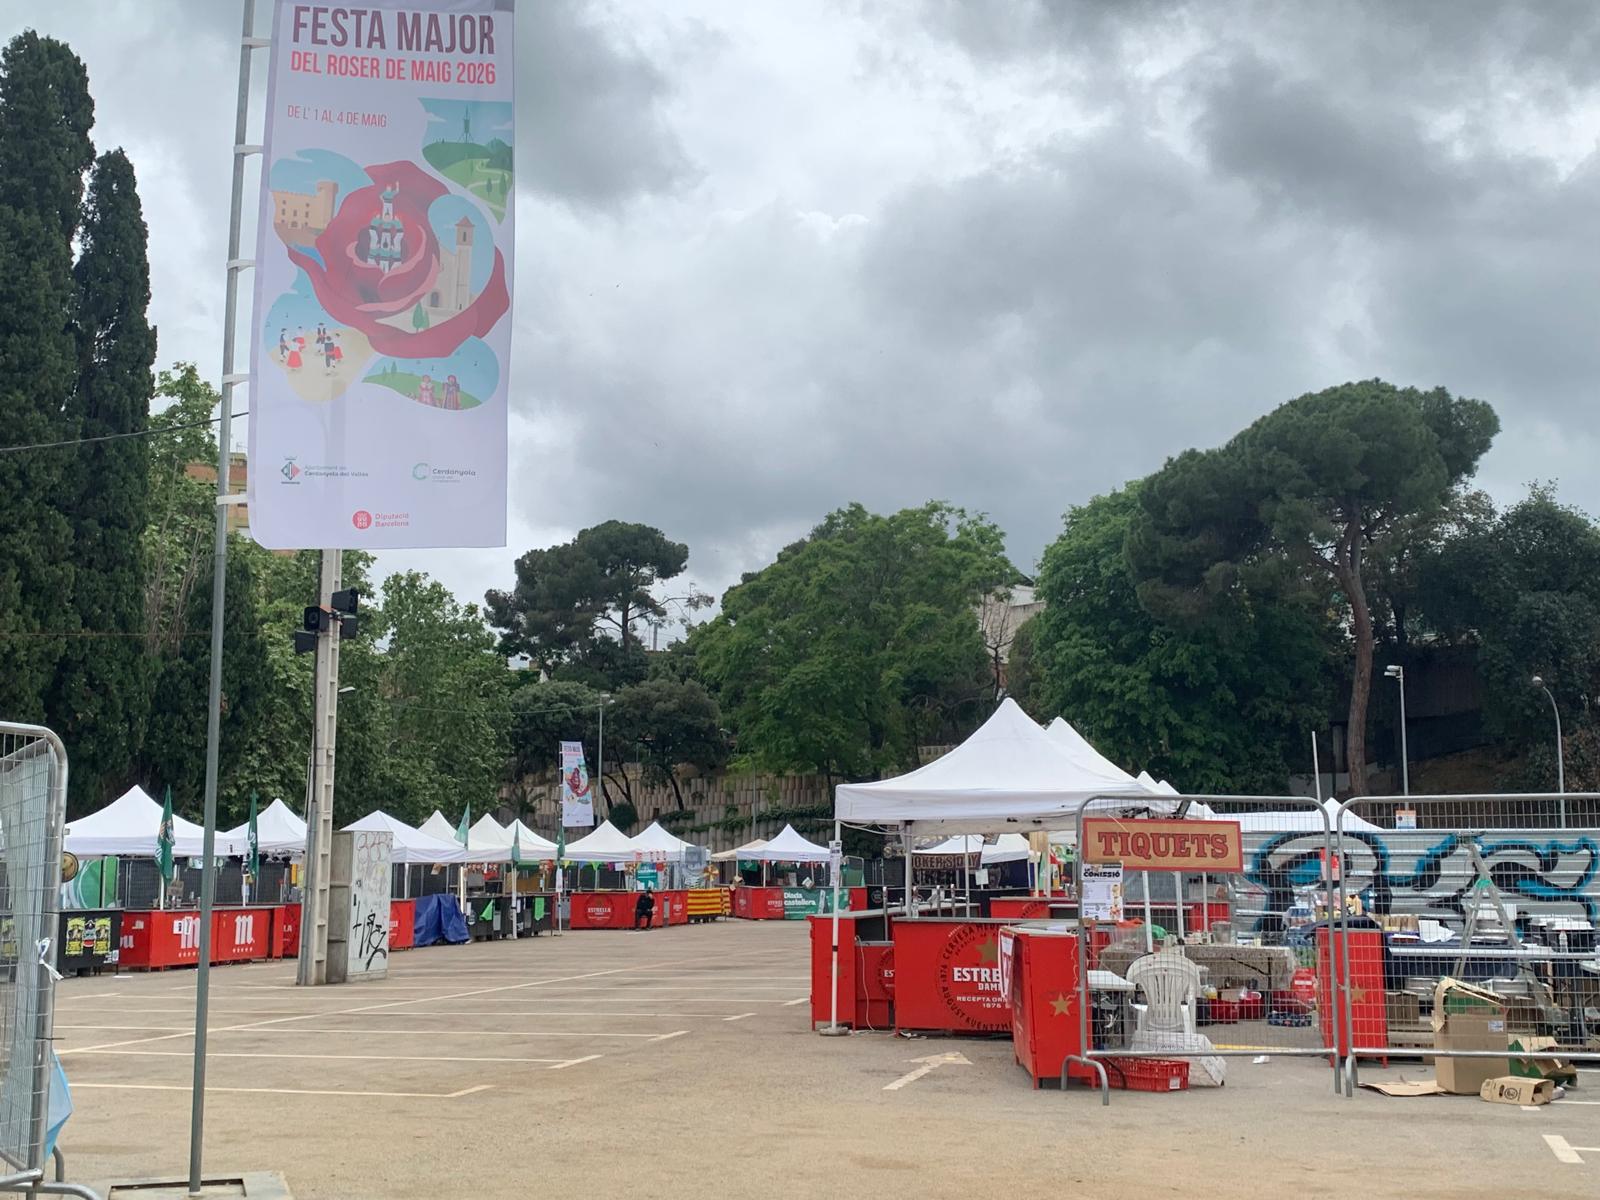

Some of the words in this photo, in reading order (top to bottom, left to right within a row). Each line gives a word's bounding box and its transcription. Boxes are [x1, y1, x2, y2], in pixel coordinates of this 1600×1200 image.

[293, 6, 386, 50] FESTA
[397, 12, 495, 55] MAJOR
[291, 50, 321, 74] DEL
[327, 54, 380, 79] ROSER
[386, 58, 406, 80] DE
[411, 60, 451, 83] MAIG
[456, 62, 496, 84] 2026
[287, 104, 301, 119] DE
[321, 109, 334, 123] AL
[336, 111, 344, 124] 4
[346, 111, 360, 125] DE
[361, 112, 387, 128] MAIG
[432, 468, 476, 476] Cerdanyola
[1098, 831, 1229, 859] TIQUETS
[912, 854, 954, 869] OKER'S
[953, 967, 1001, 982] ESTRE
